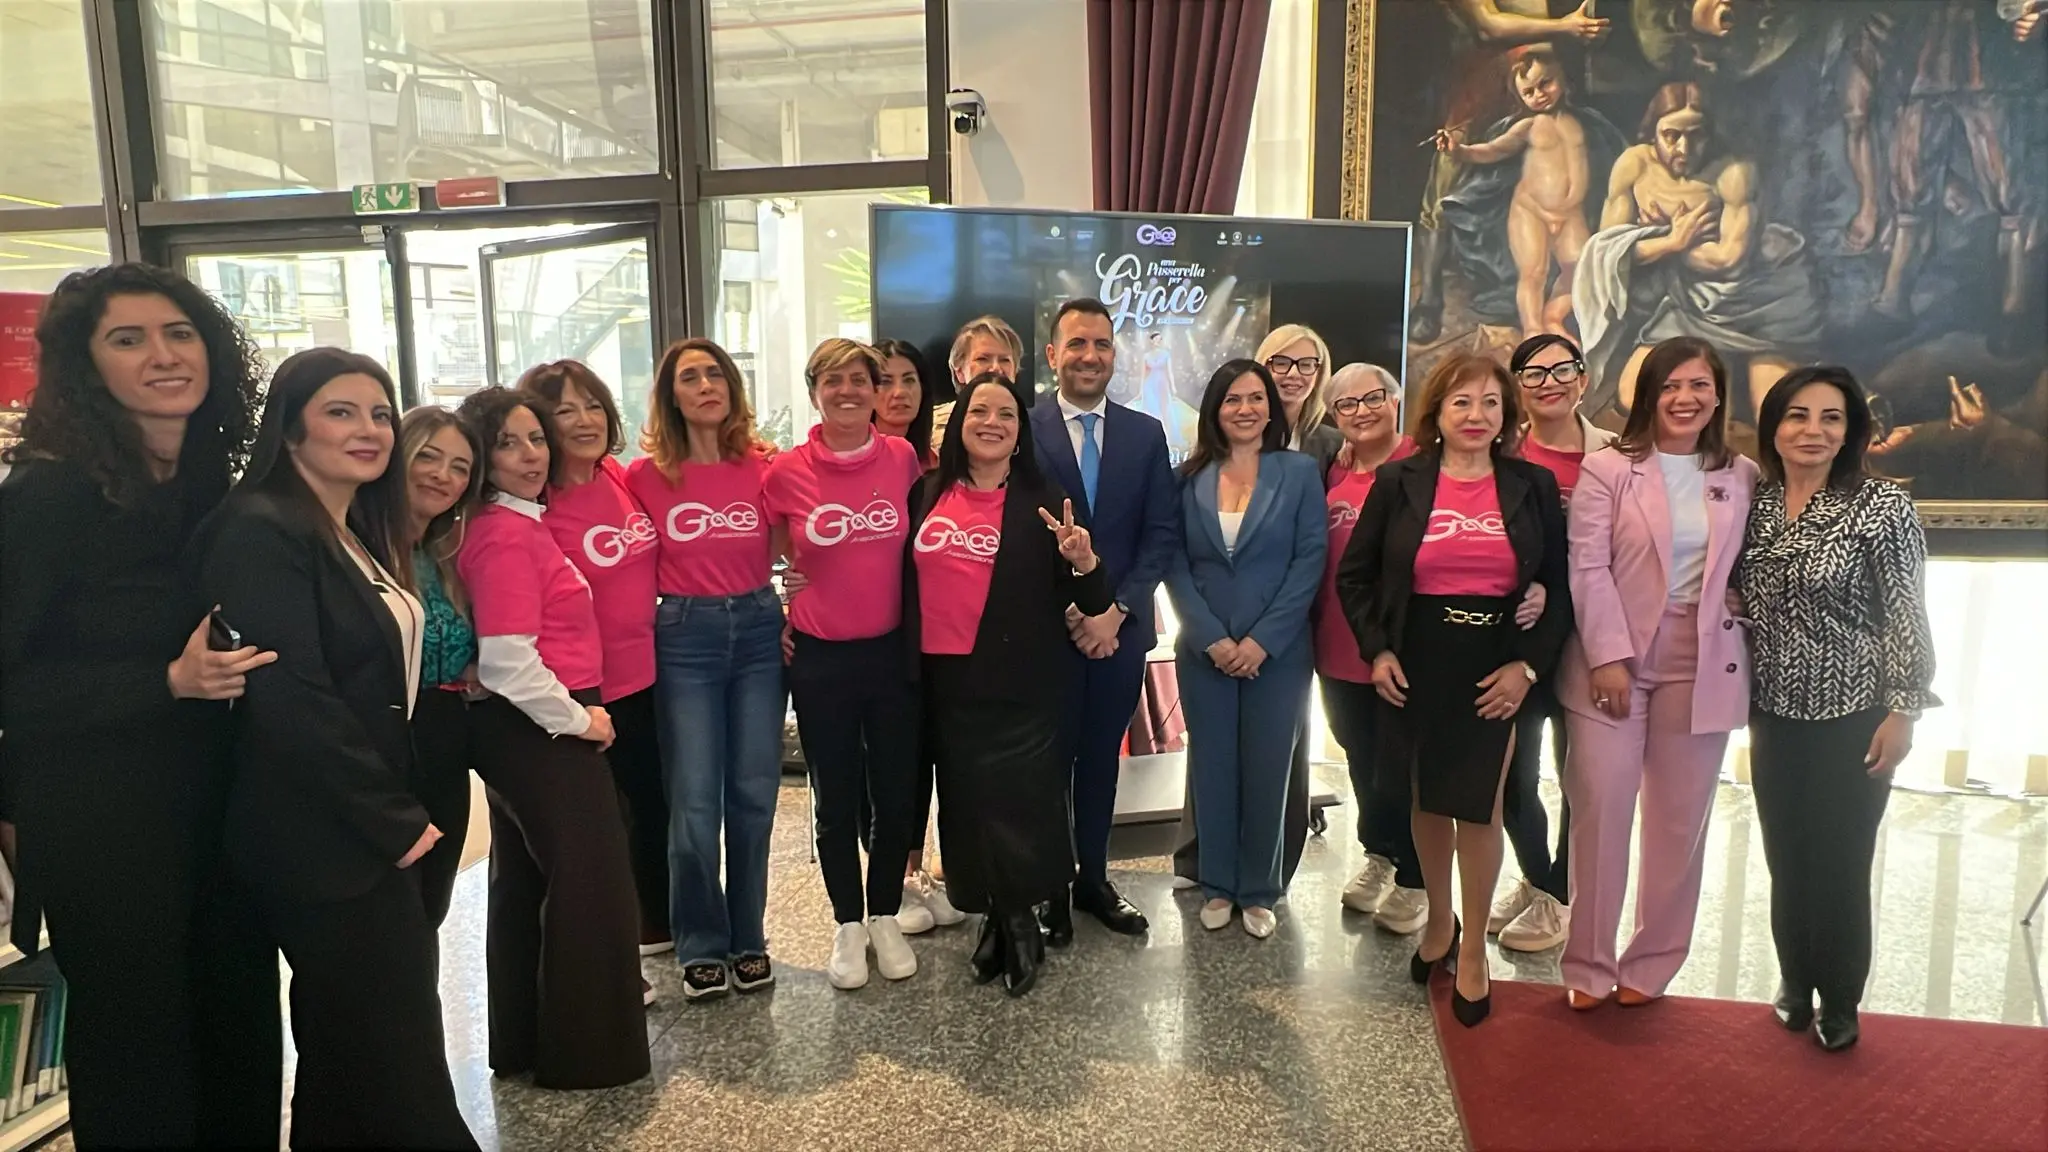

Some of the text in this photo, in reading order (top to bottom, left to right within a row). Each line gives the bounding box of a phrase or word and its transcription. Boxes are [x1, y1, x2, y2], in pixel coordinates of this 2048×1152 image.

[1146, 262, 1206, 278] Passerella
[1096, 252, 1208, 334] Grace
[583, 512, 658, 568] Grace
[666, 502, 759, 542] Grace
[805, 499, 899, 546] Grace
[914, 515, 1001, 557] Grace
